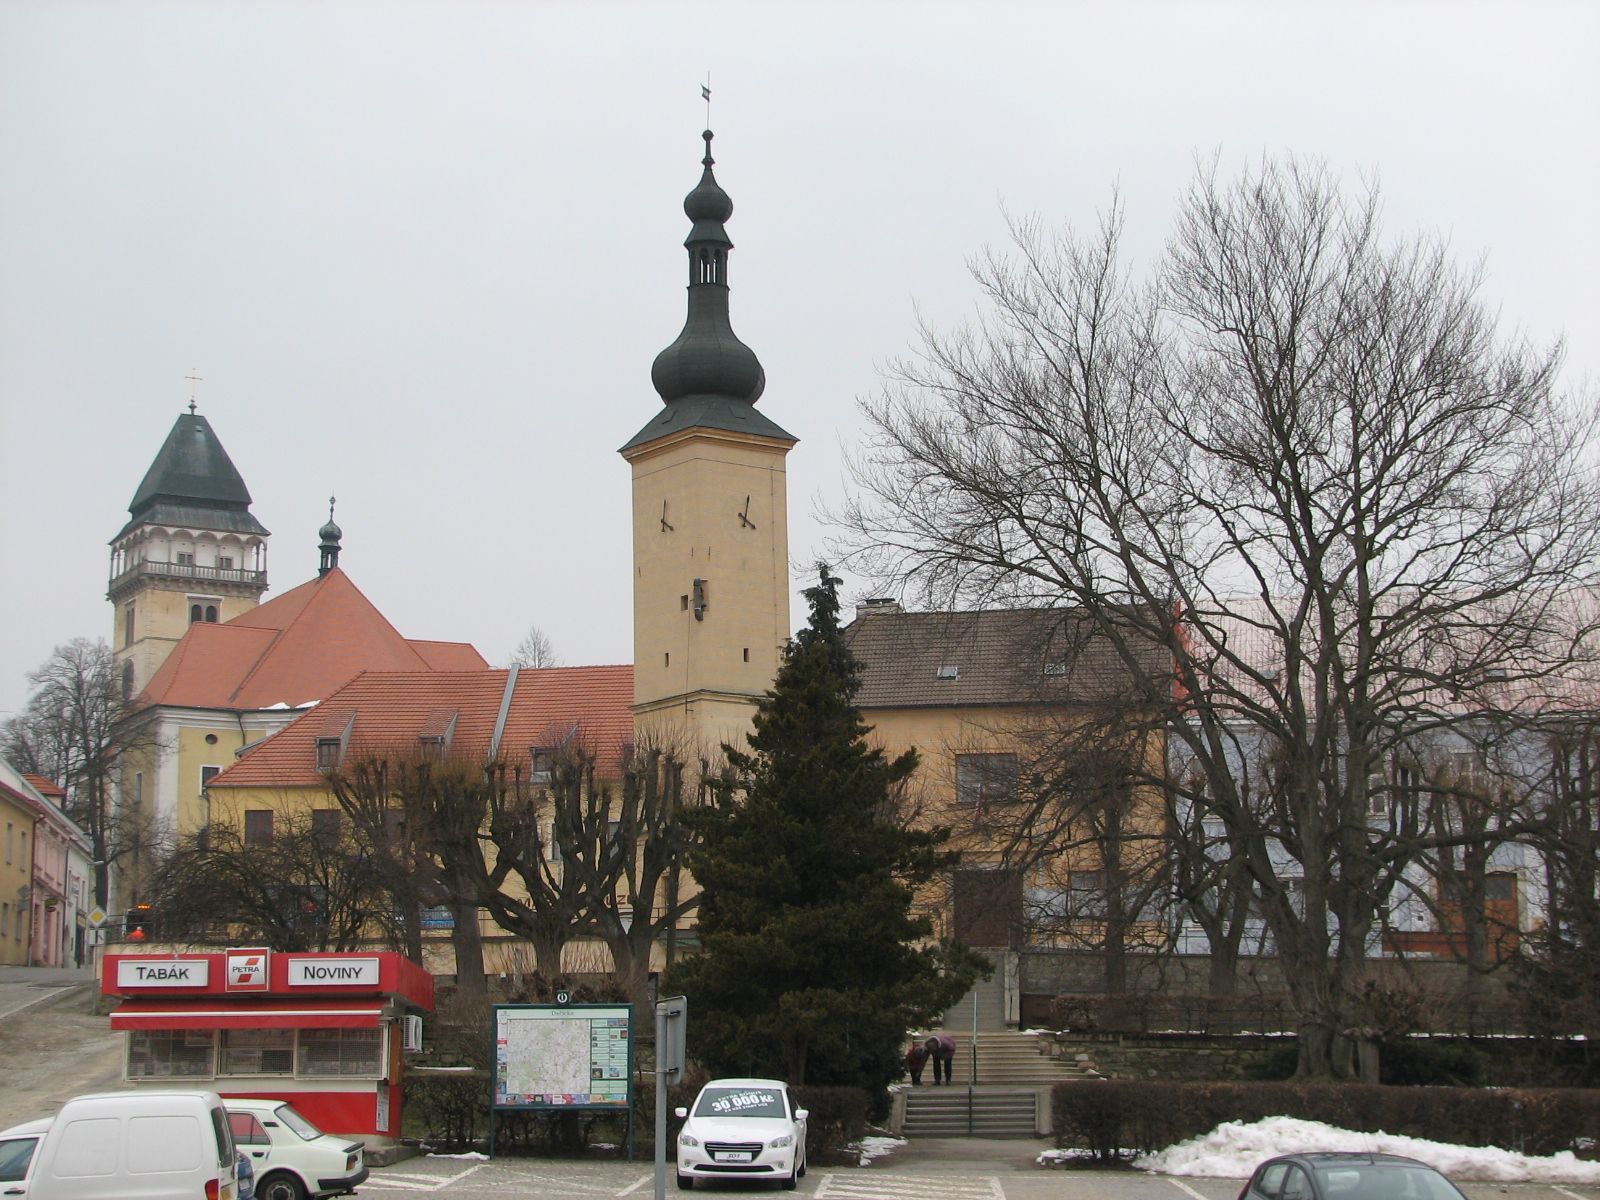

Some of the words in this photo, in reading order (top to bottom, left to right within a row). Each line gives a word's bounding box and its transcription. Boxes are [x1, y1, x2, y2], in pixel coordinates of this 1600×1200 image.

[136, 964, 190, 980] TABÁK
[304, 965, 363, 979] NOVINY
[711, 1100, 730, 1111] 30
[731, 1094, 760, 1107] 000
